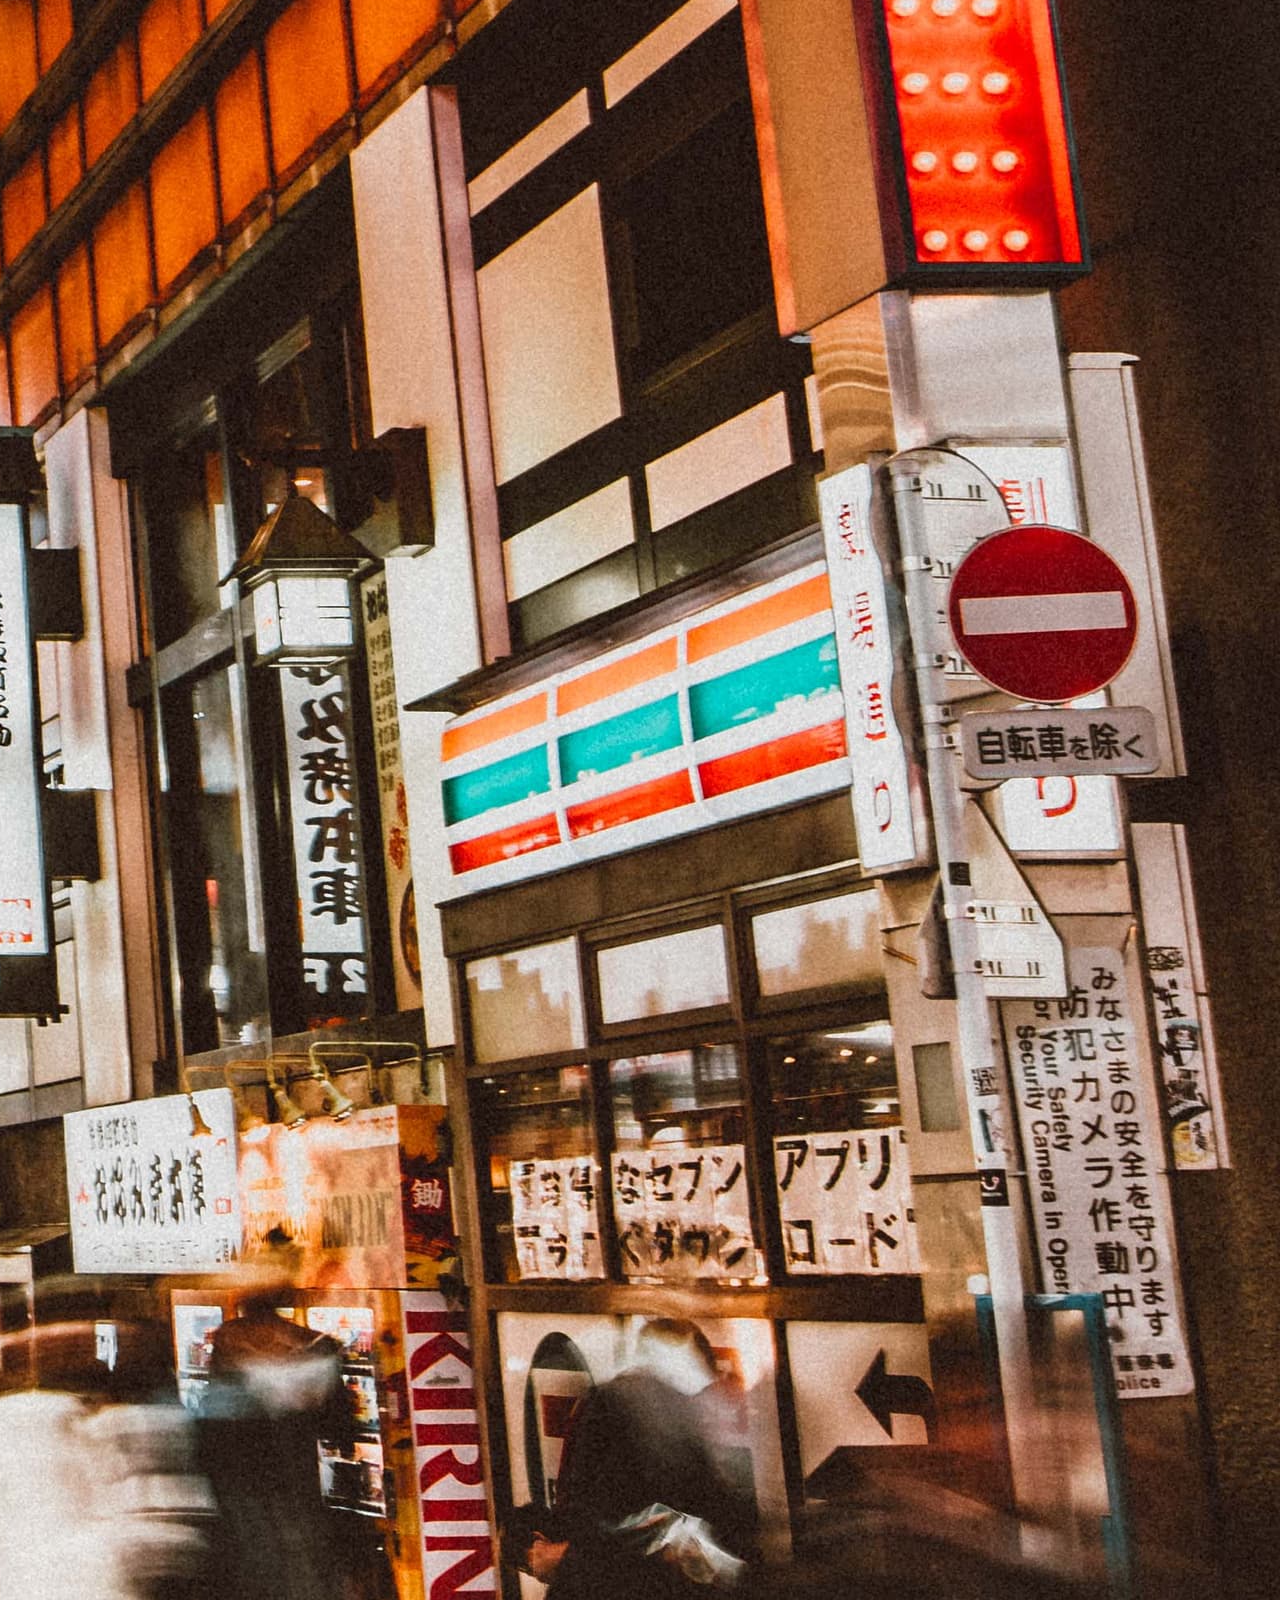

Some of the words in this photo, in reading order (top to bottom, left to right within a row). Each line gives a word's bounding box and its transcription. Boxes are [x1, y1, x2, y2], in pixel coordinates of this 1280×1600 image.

[977, 724, 1144, 765] 自転車を除く
[1016, 1025, 1043, 1112] Security
[1040, 1030, 1061, 1079] Your
[1048, 1087, 1071, 1154] Safety
[1059, 985, 1136, 1320] 防犯カメラ作動中
[1091, 966, 1172, 1338] みなさまの安全を守ります
[1029, 1120, 1057, 1203] Camera
[1044, 1210, 1062, 1230] in
[1115, 1375, 1162, 1392] olice
